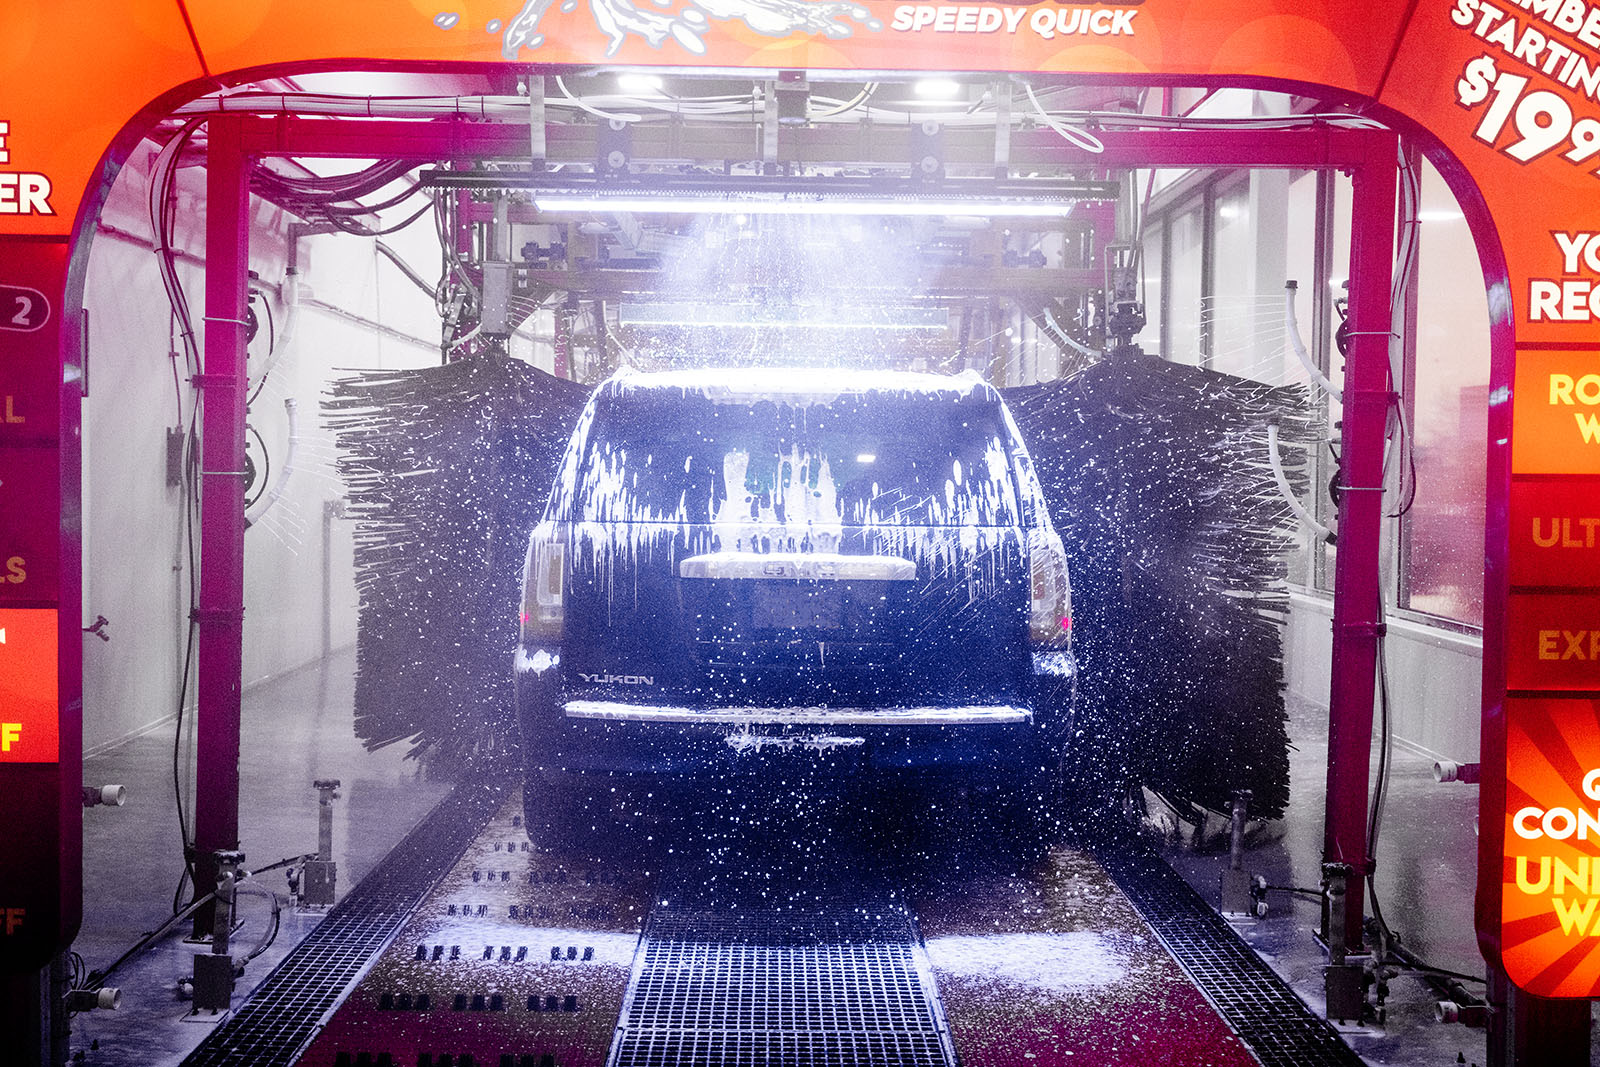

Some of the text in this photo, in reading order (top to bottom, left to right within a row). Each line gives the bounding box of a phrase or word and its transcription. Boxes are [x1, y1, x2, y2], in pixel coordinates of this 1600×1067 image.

[890, 5, 1138, 39] SPEEDY QUICK
[1508, 0, 1600, 48] MBE
[1451, 0, 1600, 105] STARTIN
[12, 296, 33, 326] 2
[0, 395, 26, 424] L
[0, 556, 27, 584] S
[578, 673, 654, 686] YUKON
